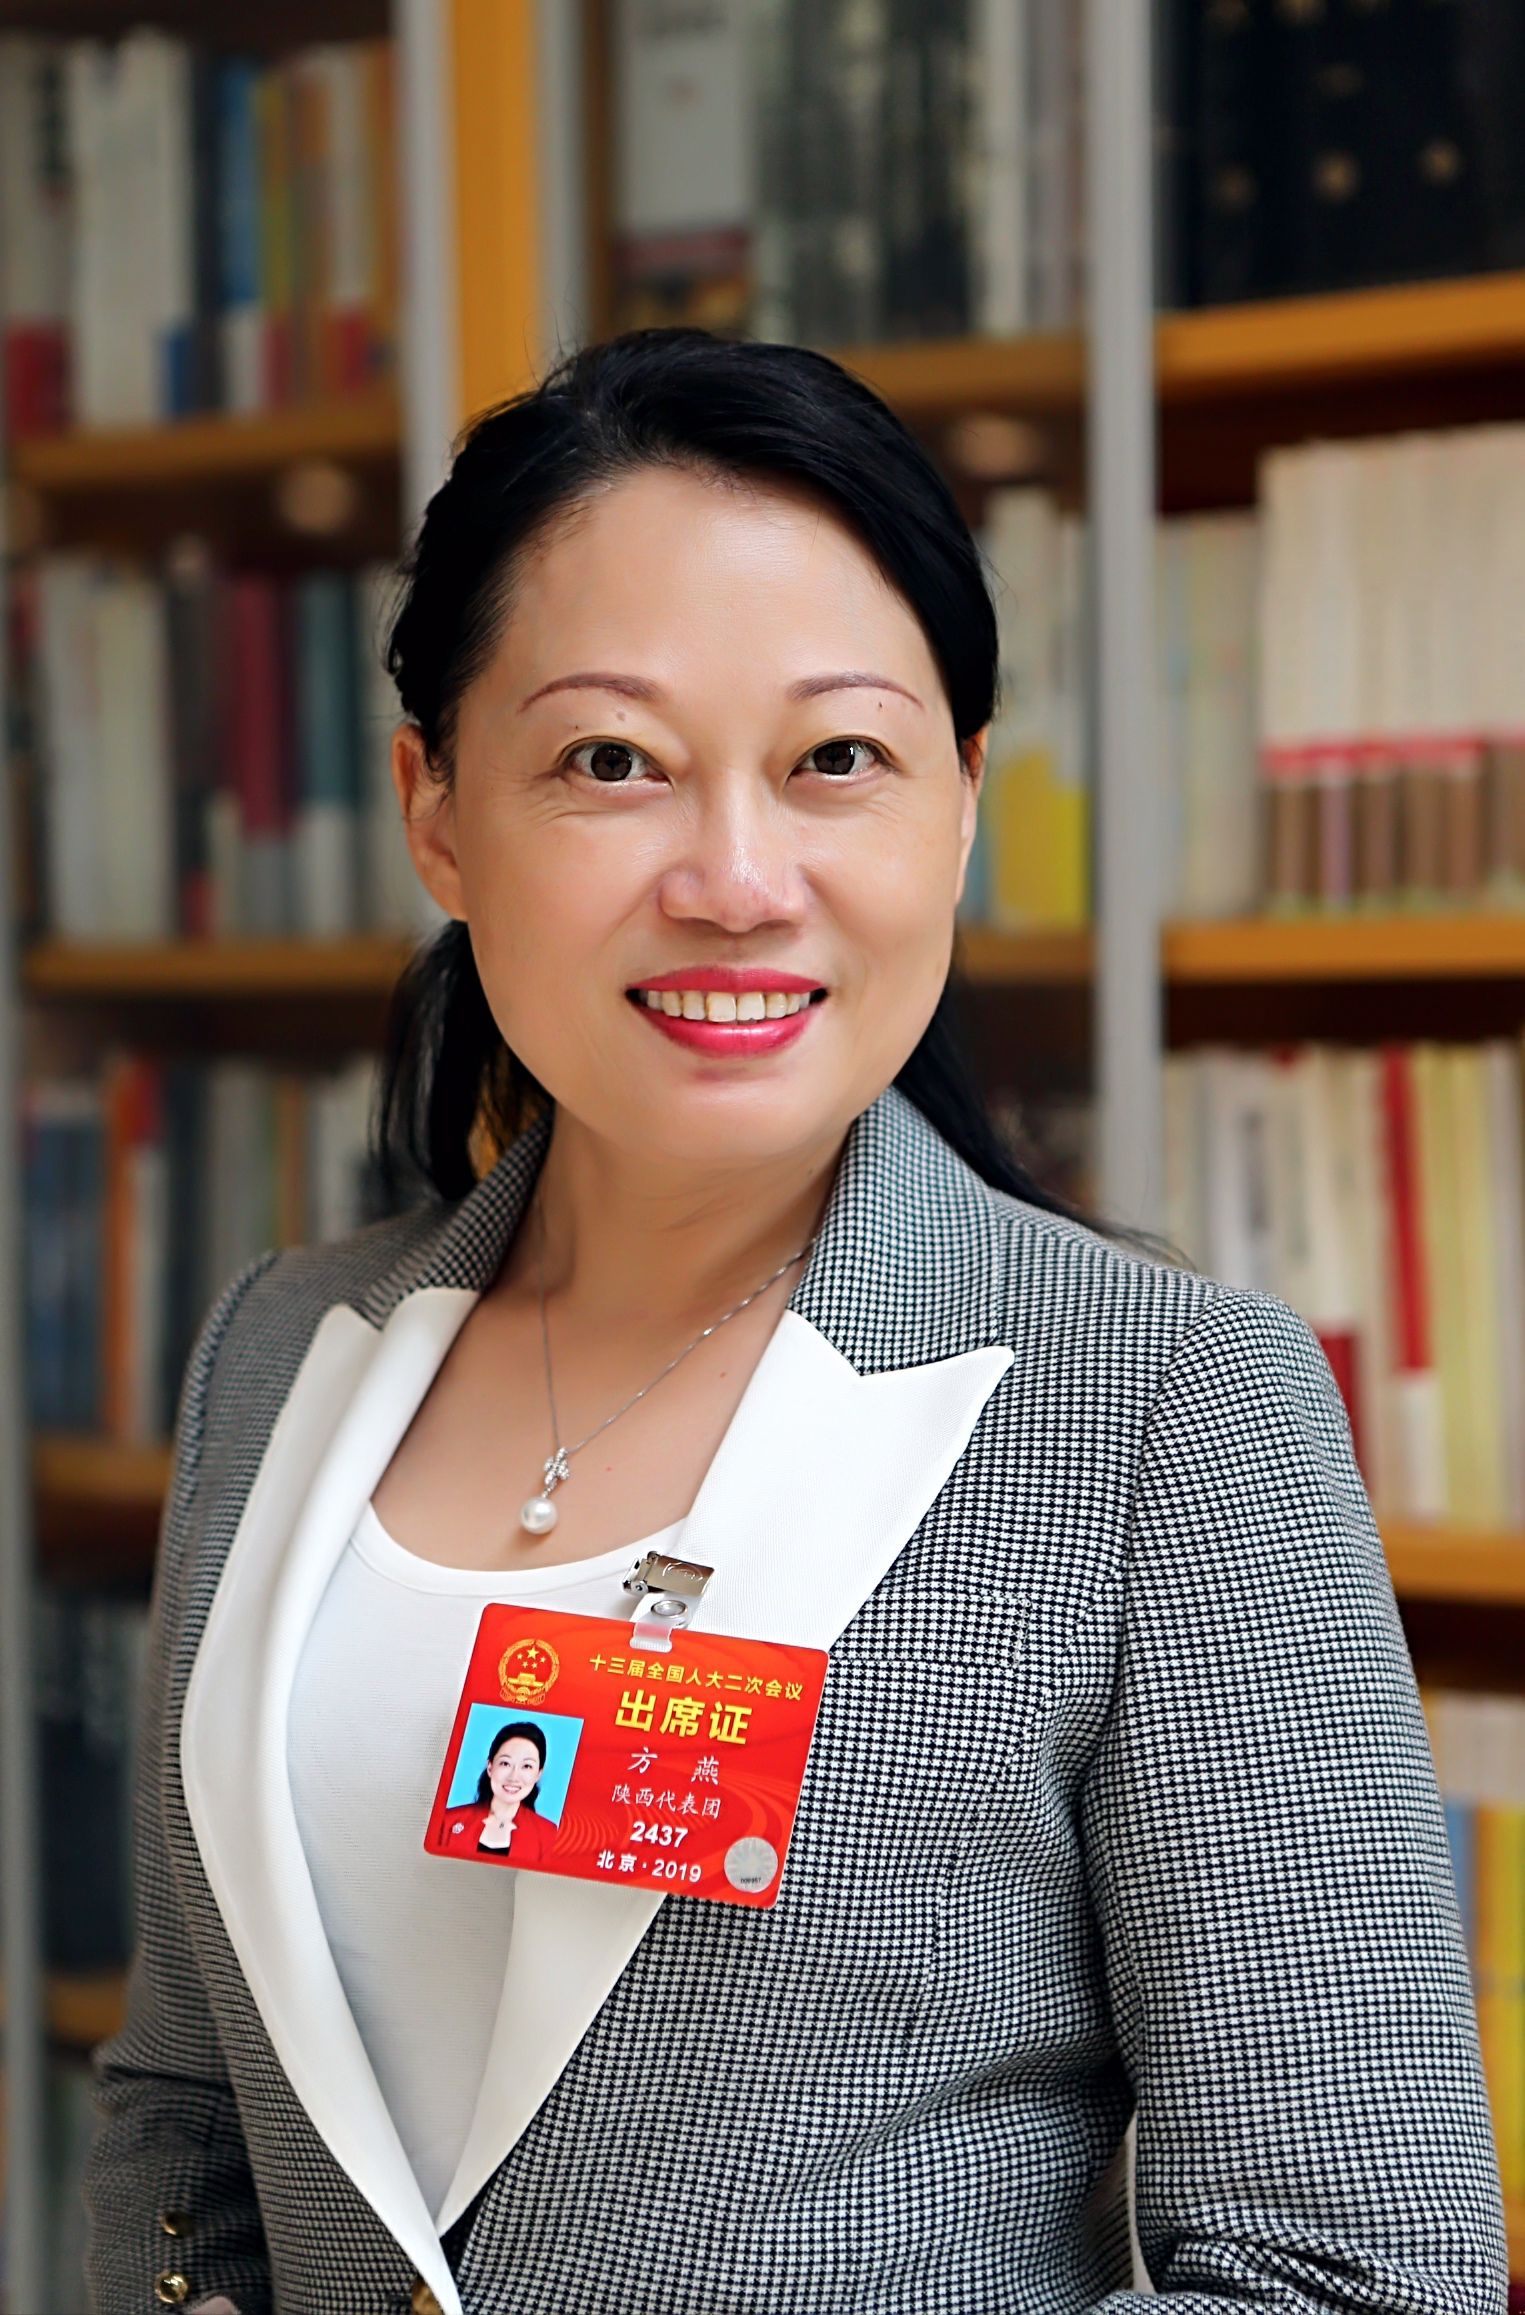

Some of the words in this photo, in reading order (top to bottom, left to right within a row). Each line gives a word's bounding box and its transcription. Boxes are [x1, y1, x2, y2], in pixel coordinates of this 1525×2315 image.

[589, 1654, 803, 1701] 十三届全国人大二次会议
[615, 1689, 753, 1744] 出席证
[611, 1784, 721, 1818] 陕西代表团
[630, 1821, 688, 1848] 2437
